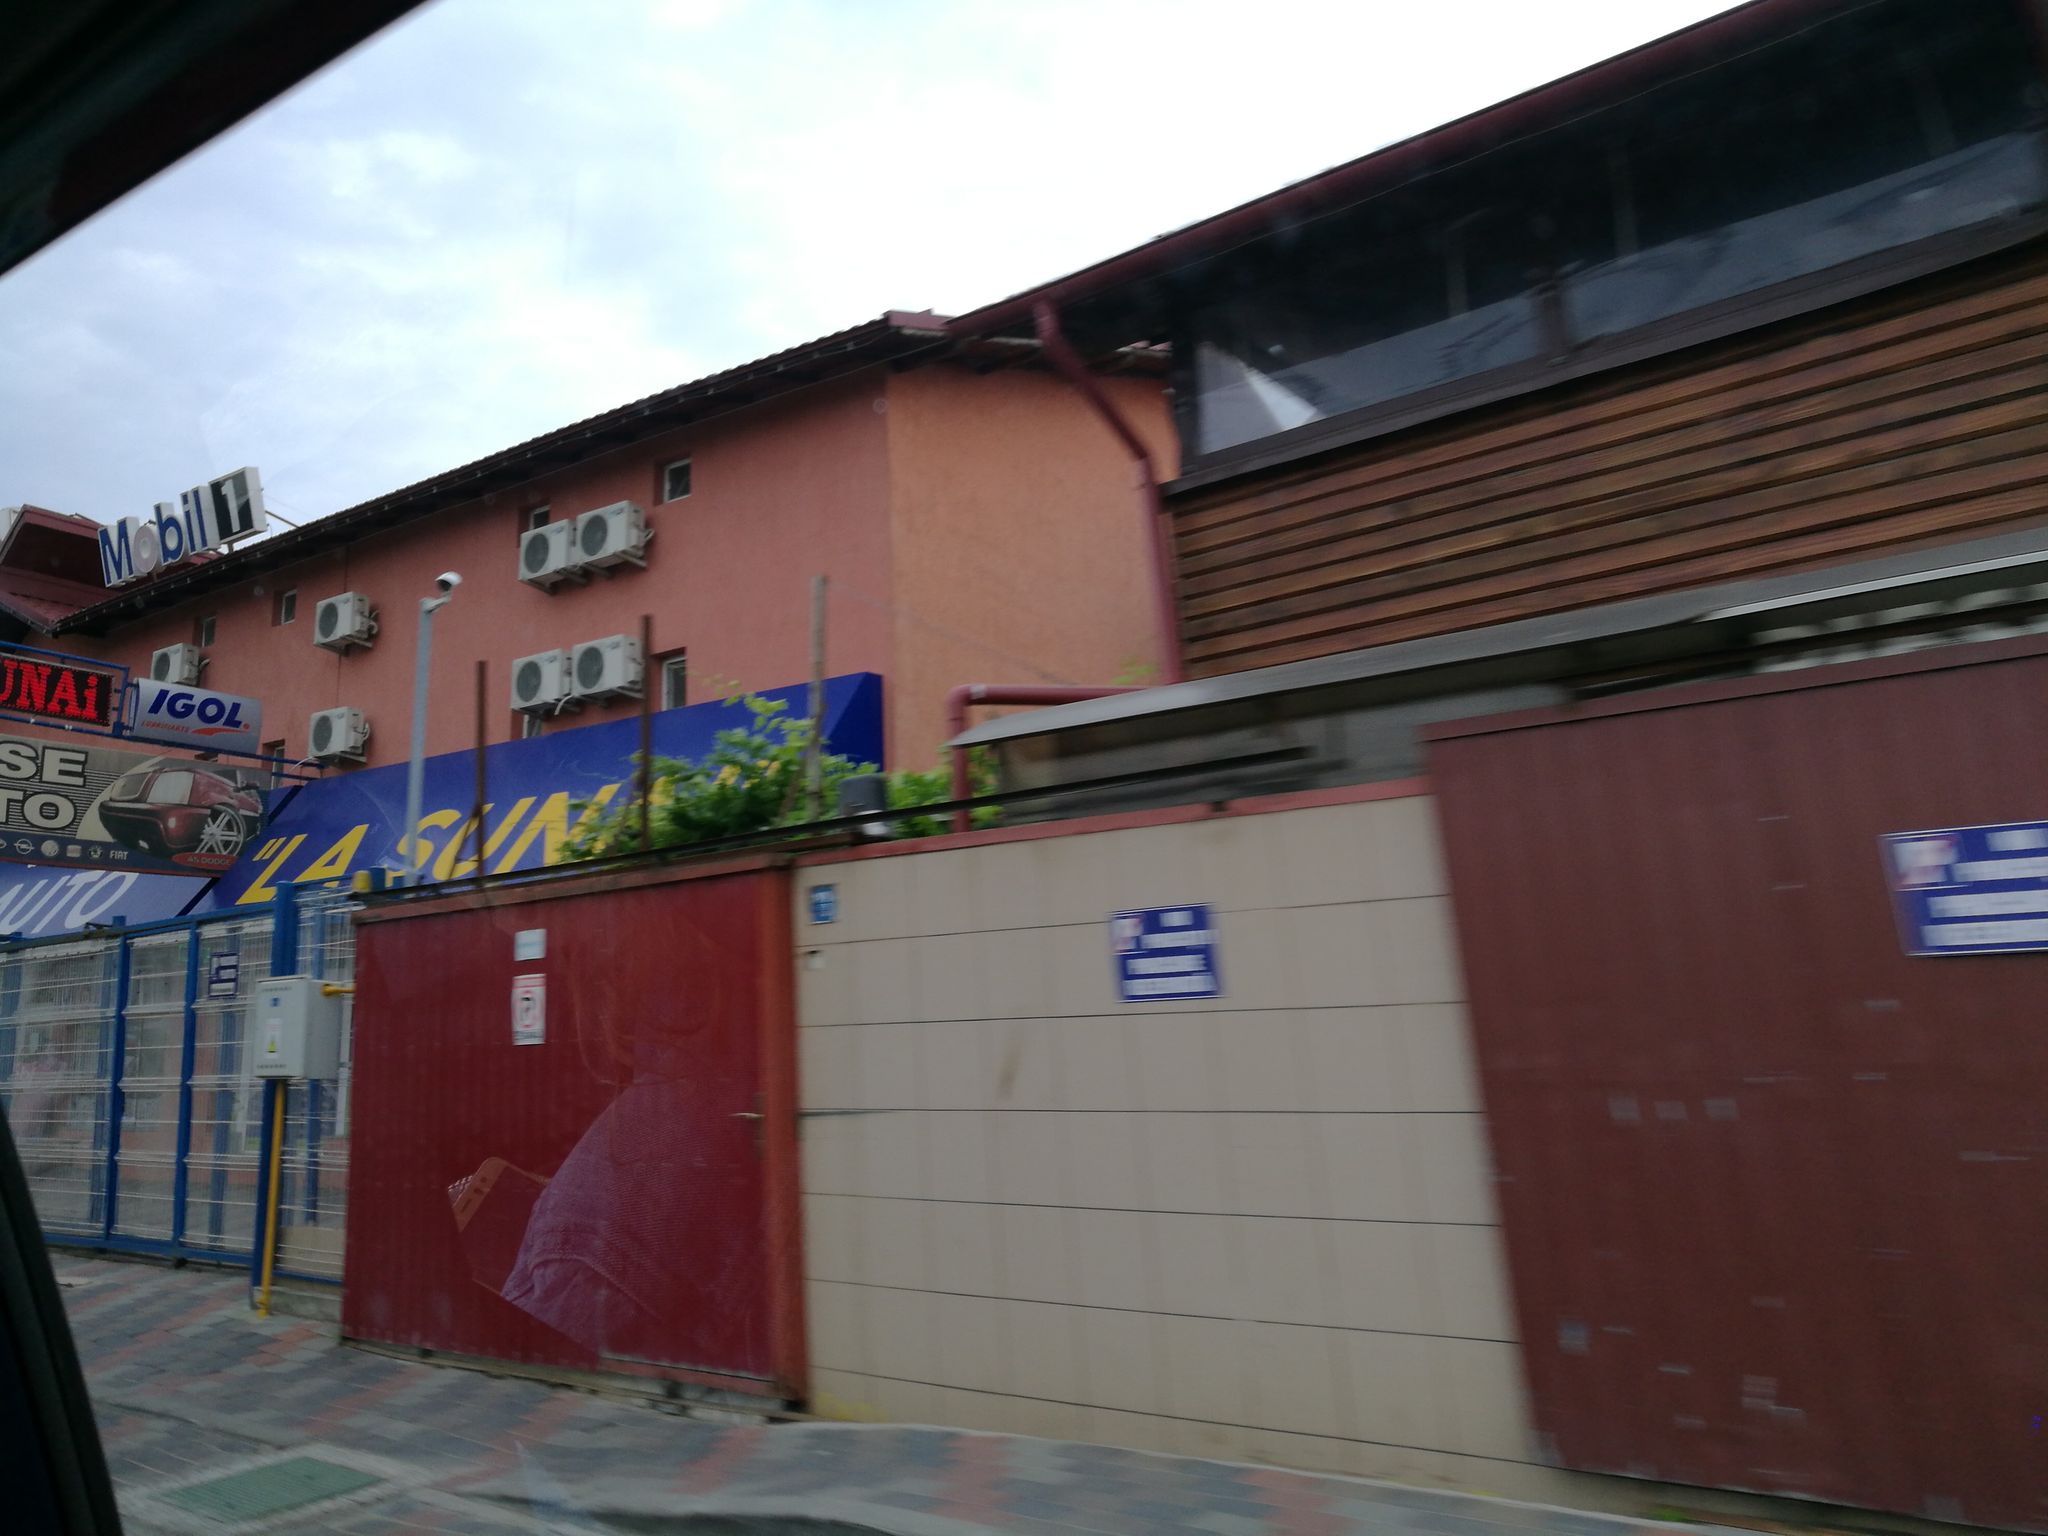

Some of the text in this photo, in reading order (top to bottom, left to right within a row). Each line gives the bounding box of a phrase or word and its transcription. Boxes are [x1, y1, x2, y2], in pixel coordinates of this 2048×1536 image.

[98, 478, 242, 586] Mobil 1
[148, 689, 242, 729] IGOL
[109, 850, 129, 860] FIAT
